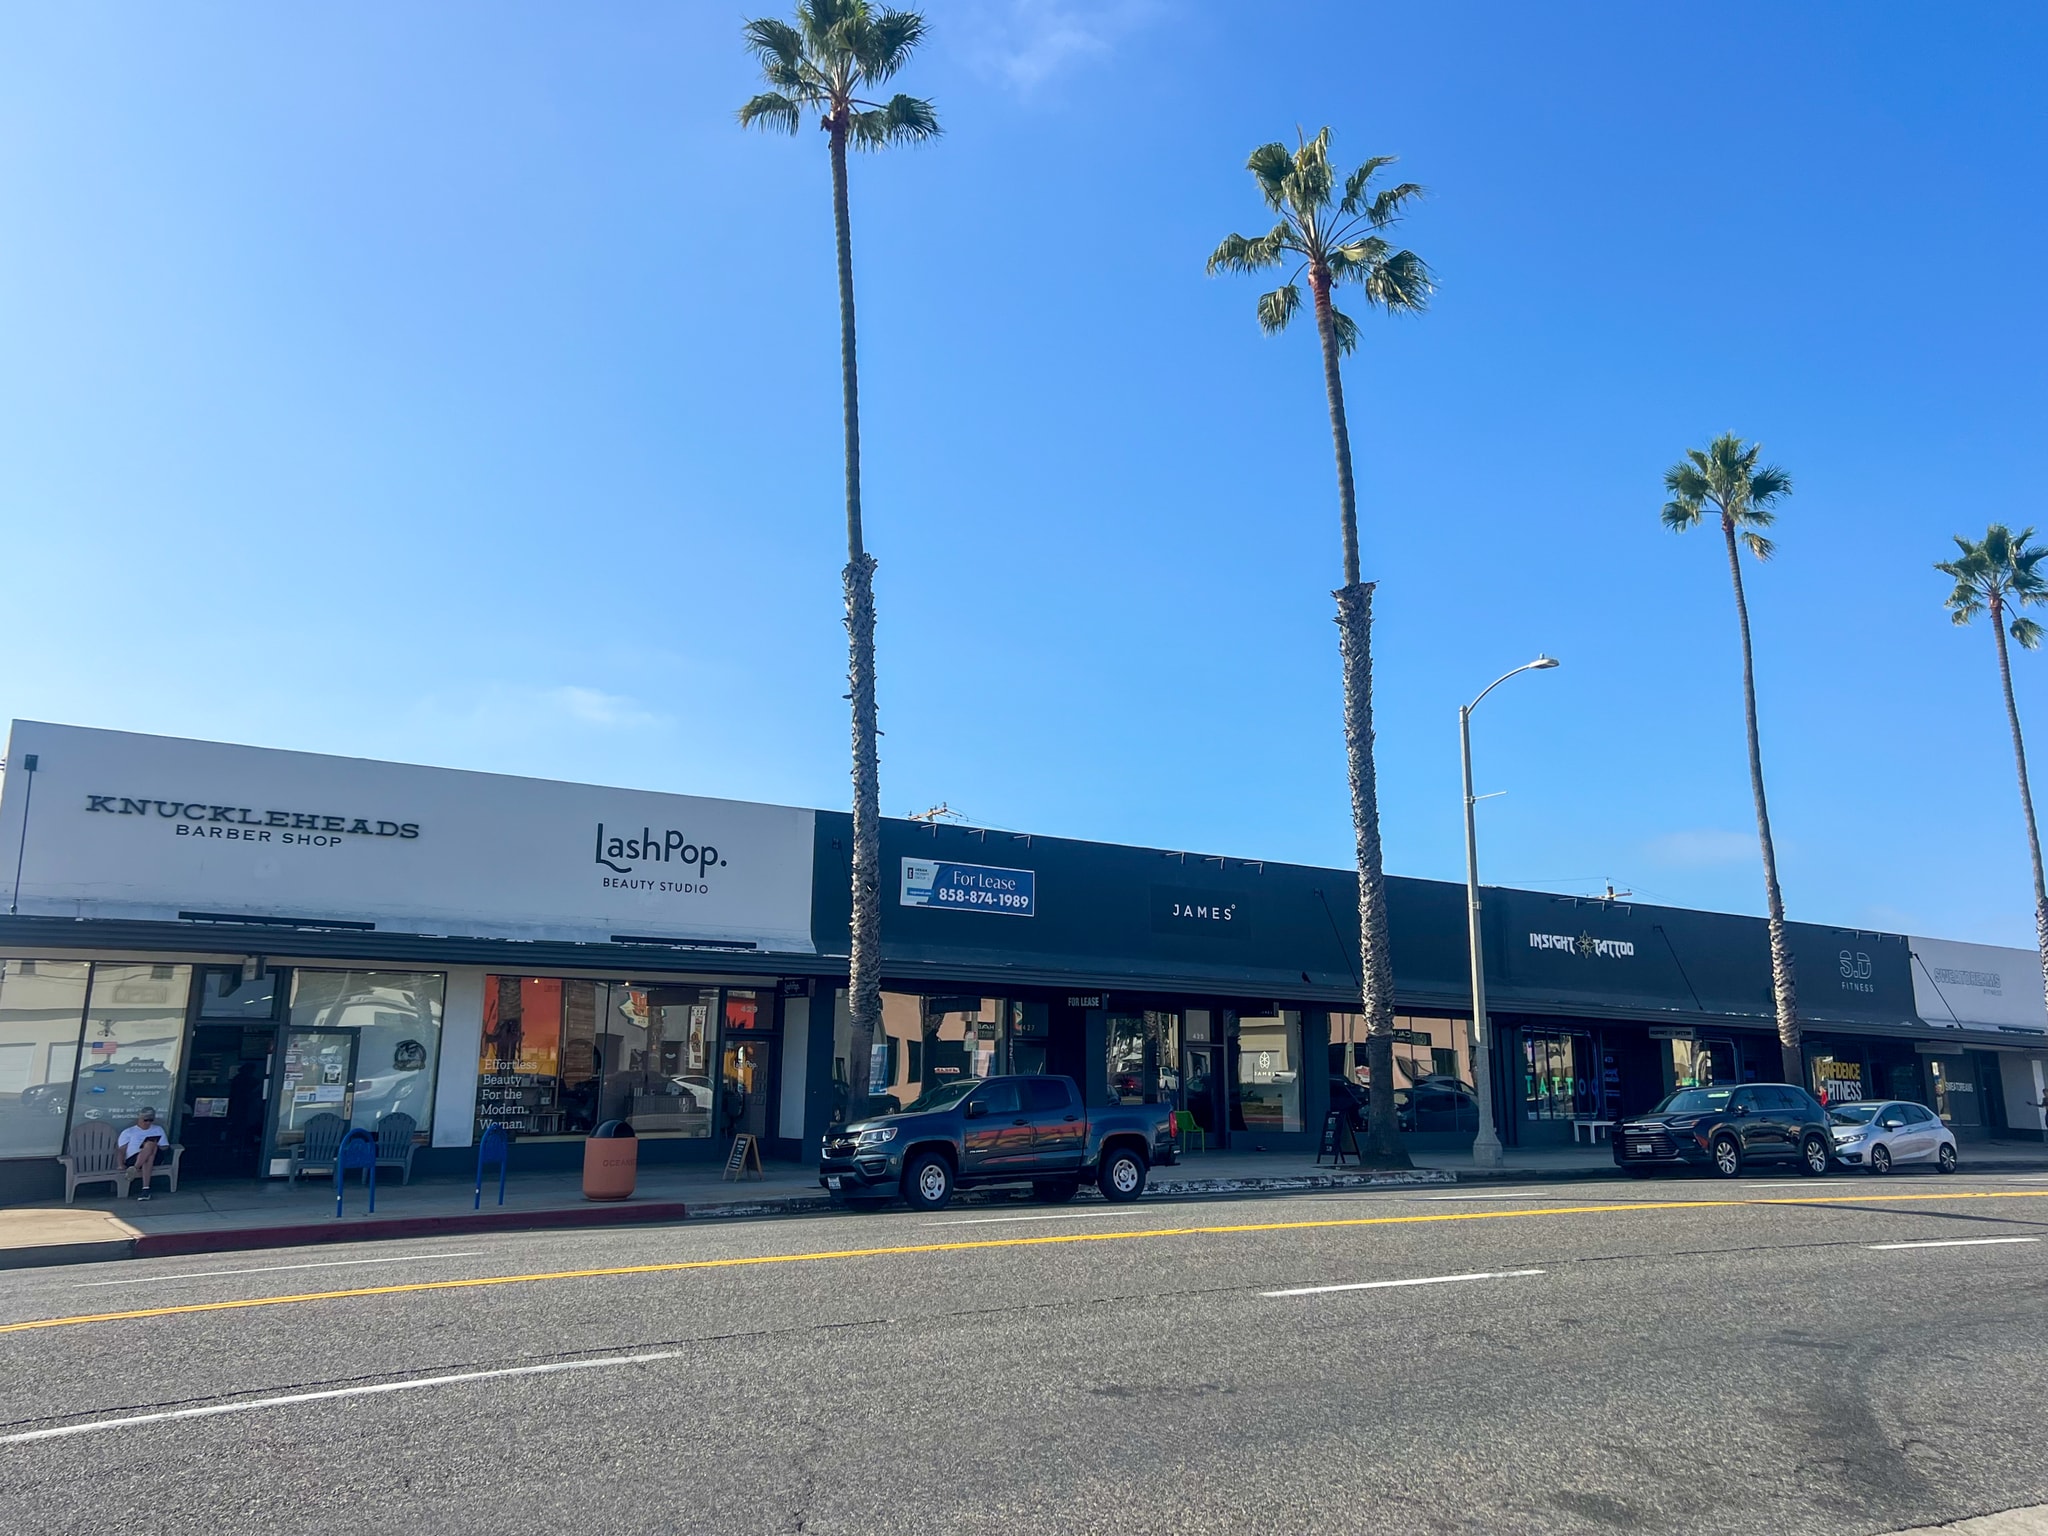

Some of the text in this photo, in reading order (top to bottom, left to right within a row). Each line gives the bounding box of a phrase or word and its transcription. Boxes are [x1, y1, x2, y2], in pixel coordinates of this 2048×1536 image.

[86, 795, 420, 839] KNUCKLEHEADS
[176, 824, 342, 848] BARBER SHOP
[595, 822, 727, 879] LashPop.
[603, 877, 709, 894] BEAUTY STUDIO
[953, 870, 1016, 891] For Lease
[939, 887, 1029, 909] 858-874-1989
[1529, 933, 1634, 959] INSIGHT TATTOO
[1841, 981, 1875, 993] FITNESS
[1067, 997, 1100, 1007] FOR LEASE
[484, 1059, 538, 1070] Effortless
[483, 1074, 522, 1087] Beauty
[1827, 1080, 1862, 1101] FITNESS
[481, 1088, 522, 1100] For the
